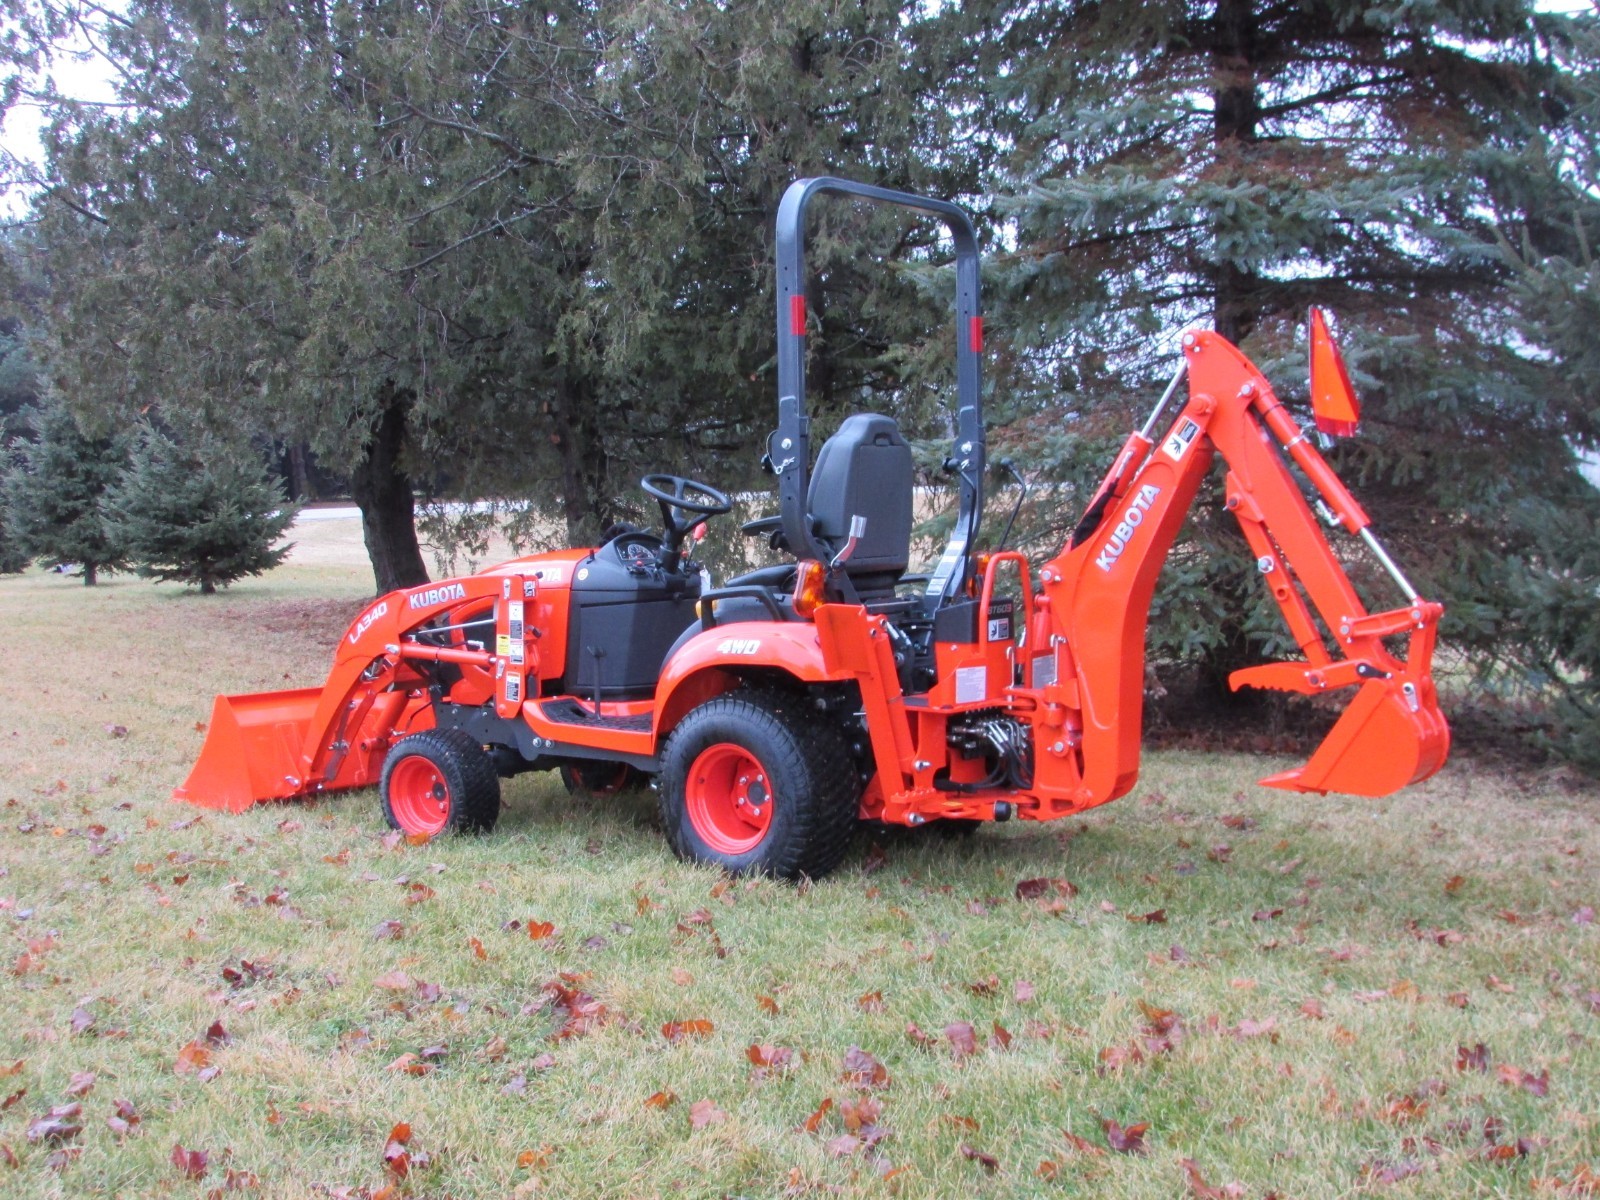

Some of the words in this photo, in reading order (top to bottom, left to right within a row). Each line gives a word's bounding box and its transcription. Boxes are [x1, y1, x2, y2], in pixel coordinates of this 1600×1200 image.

[1095, 484, 1161, 572] KUBOTA
[409, 583, 466, 609] KUBOTA
[349, 601, 387, 644] LA340
[717, 639, 761, 655] 4WD
